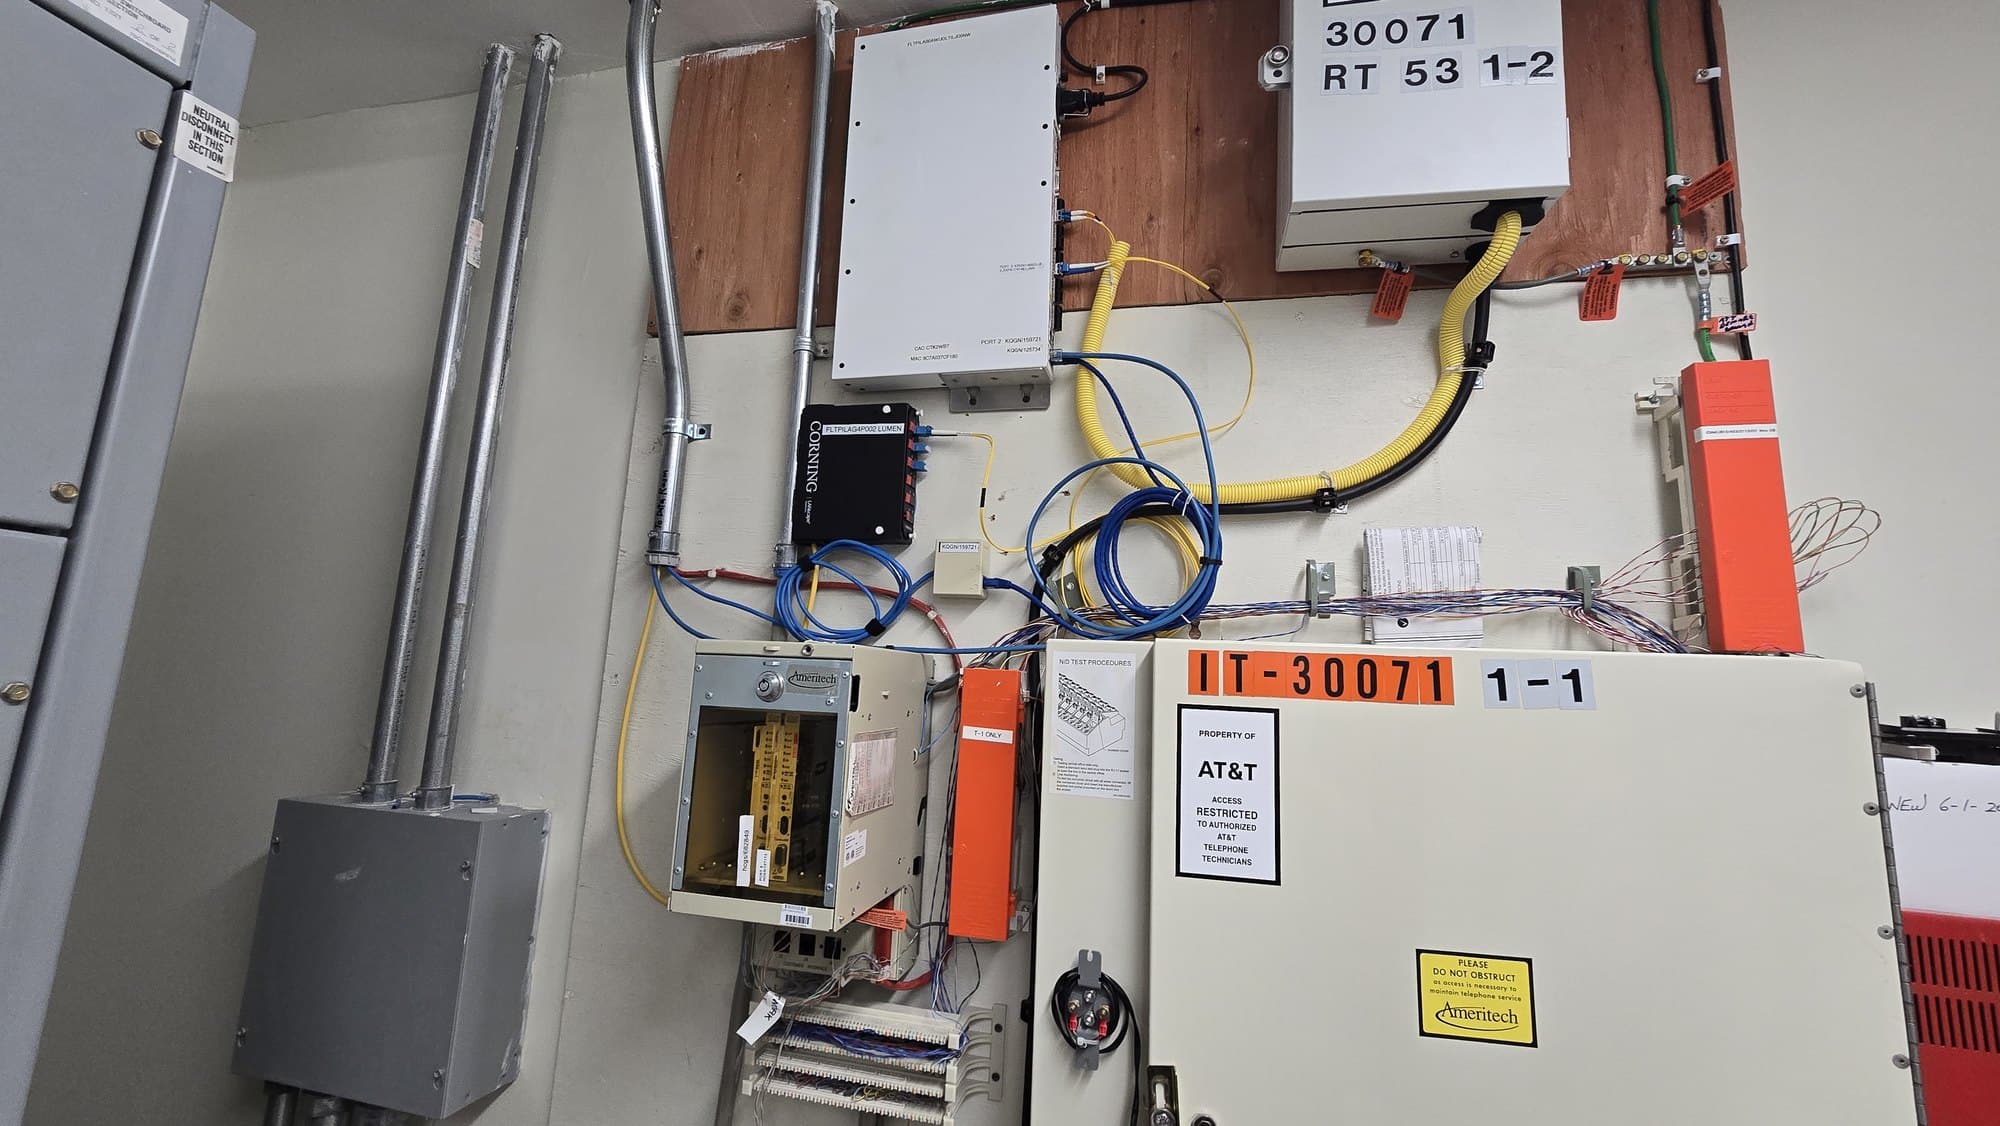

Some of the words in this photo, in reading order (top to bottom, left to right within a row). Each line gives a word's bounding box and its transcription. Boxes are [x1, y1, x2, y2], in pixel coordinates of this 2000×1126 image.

[1326, 13, 1465, 46] 30071
[1323, 63, 1377, 90] RT
[1404, 57, 1459, 86] 53
[1483, 51, 1554, 81] 1-2
[193, 104, 231, 133] NEUTRAL
[181, 112, 235, 146] DISCONNECT
[193, 130, 202, 142] IN
[205, 136, 224, 153] THIS
[188, 140, 224, 164] SECTION
[806, 421, 821, 493] CORNING
[789, 670, 837, 684] Ameritech
[1487, 666, 1584, 702] 1-1
[985, 731, 1002, 739] ONLY
[1199, 729, 1242, 739] PROPERTY
[1244, 732, 1256, 740] OF
[1198, 760, 1258, 781] AT&T
[1212, 796, 1242, 805] ACCESS
[1196, 807, 1258, 820] RESTRICTED
[1198, 820, 1207, 828] TO
[1209, 821, 1257, 832] AUTHORIZED
[1217, 833, 1237, 841] AT&T
[1203, 843, 1249, 854] TELEPHONE
[1202, 855, 1252, 866] TECHNICIANS
[1458, 959, 1489, 969] PLEASE
[1433, 968, 1446, 976] DO
[1450, 969, 1468, 978] NOT
[1470, 971, 1516, 982] OBSTRUCT
[1474, 983, 1507, 992] necessary
[1430, 988, 1459, 996] maintain
[1461, 990, 1496, 1000] telephone
[1498, 994, 1522, 1002] service
[1440, 1001, 1519, 1025] Ameritech
